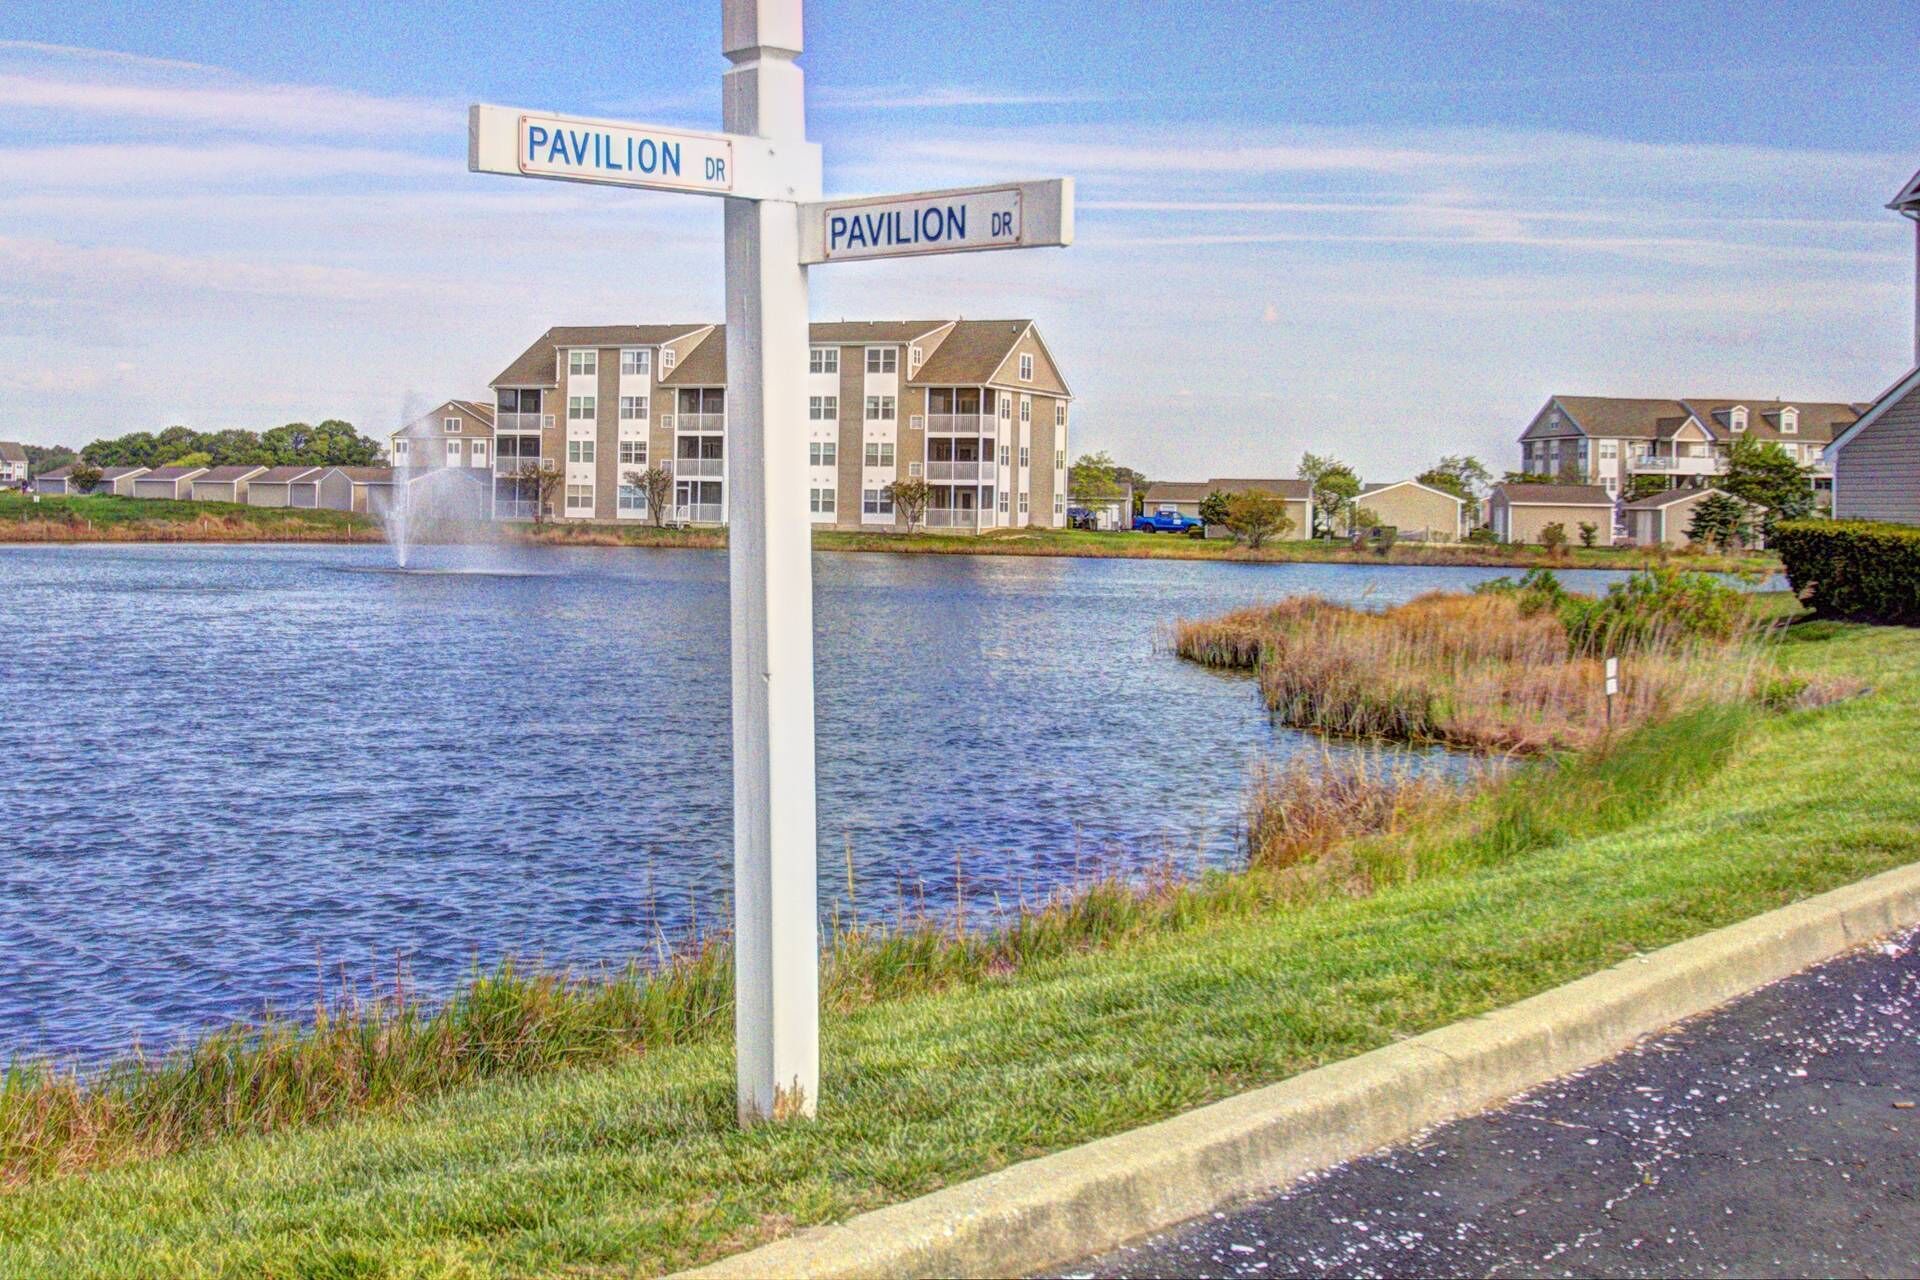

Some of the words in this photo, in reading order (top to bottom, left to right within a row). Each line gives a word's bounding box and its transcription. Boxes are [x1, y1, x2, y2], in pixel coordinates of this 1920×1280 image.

[529, 126, 681, 176] PAVILION
[705, 157, 726, 182] DR
[831, 205, 966, 250] PAVILION
[992, 212, 1013, 237] DR
